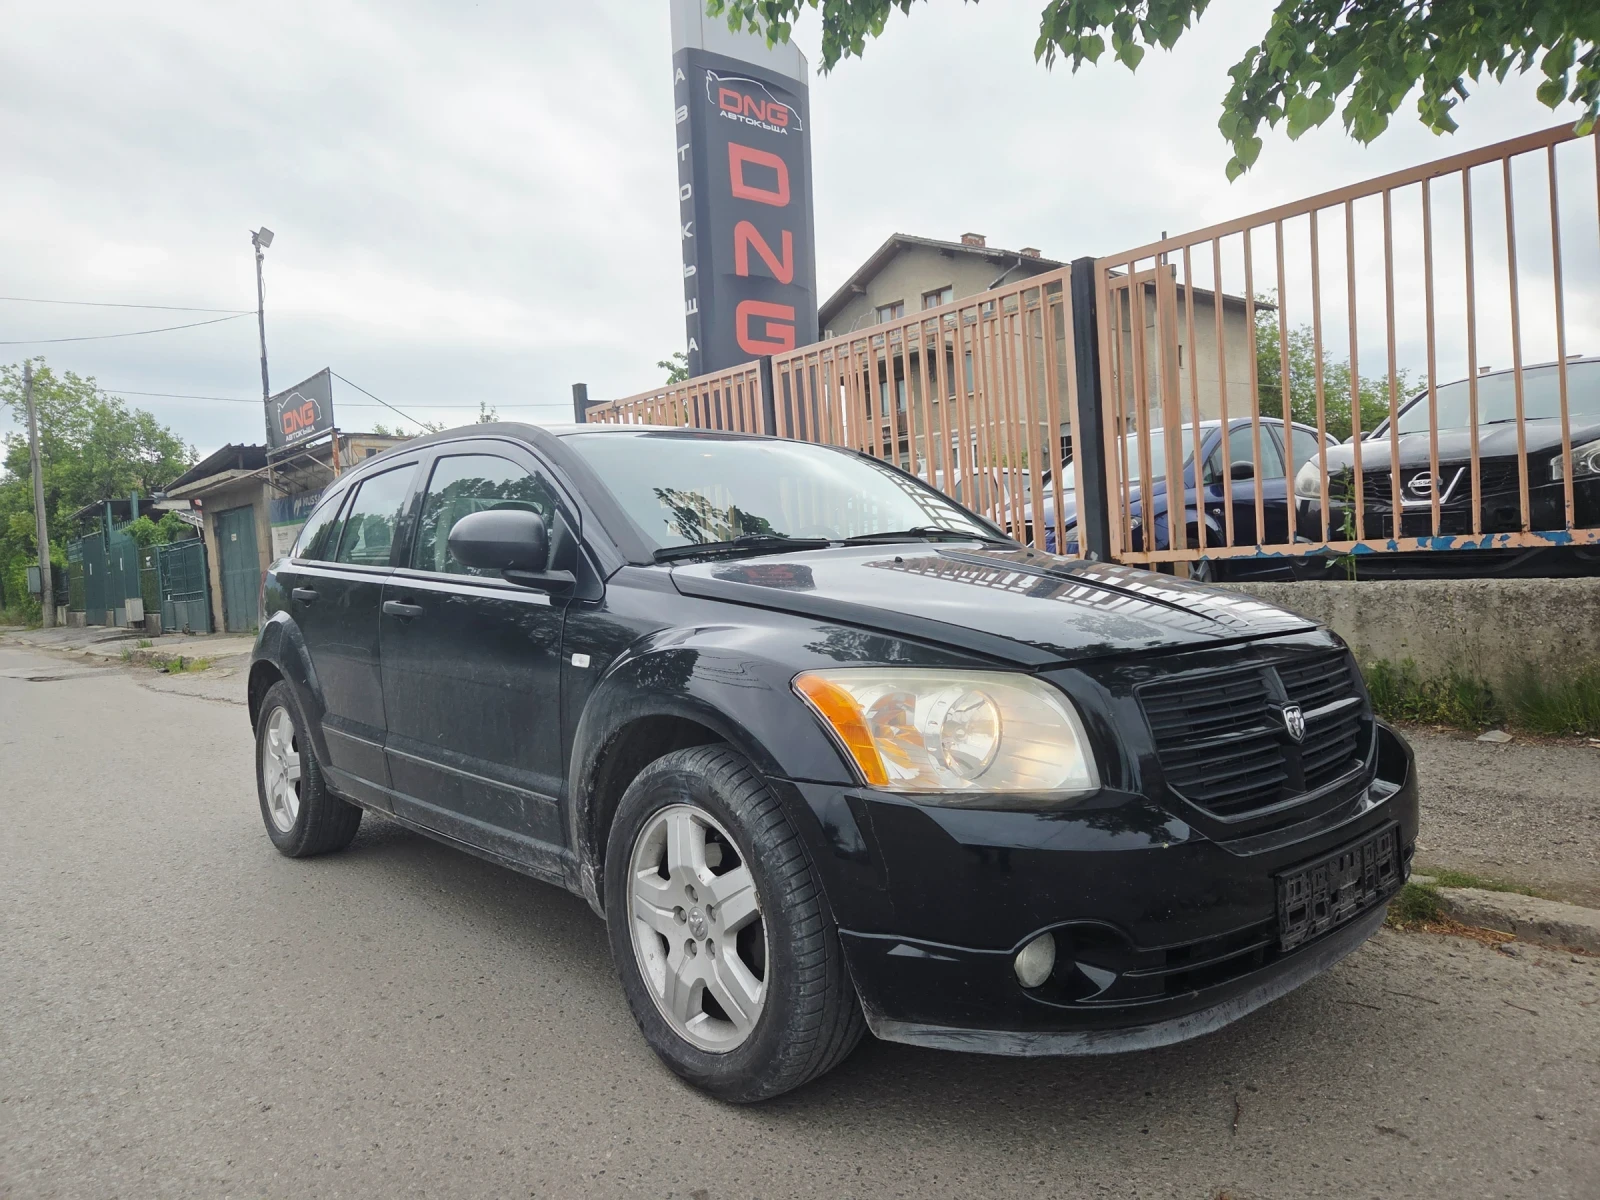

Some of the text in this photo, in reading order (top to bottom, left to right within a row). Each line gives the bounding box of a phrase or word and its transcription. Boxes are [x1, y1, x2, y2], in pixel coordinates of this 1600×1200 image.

[719, 87, 788, 127] DNG
[728, 142, 796, 356] DNG
[282, 401, 315, 435] DNG
